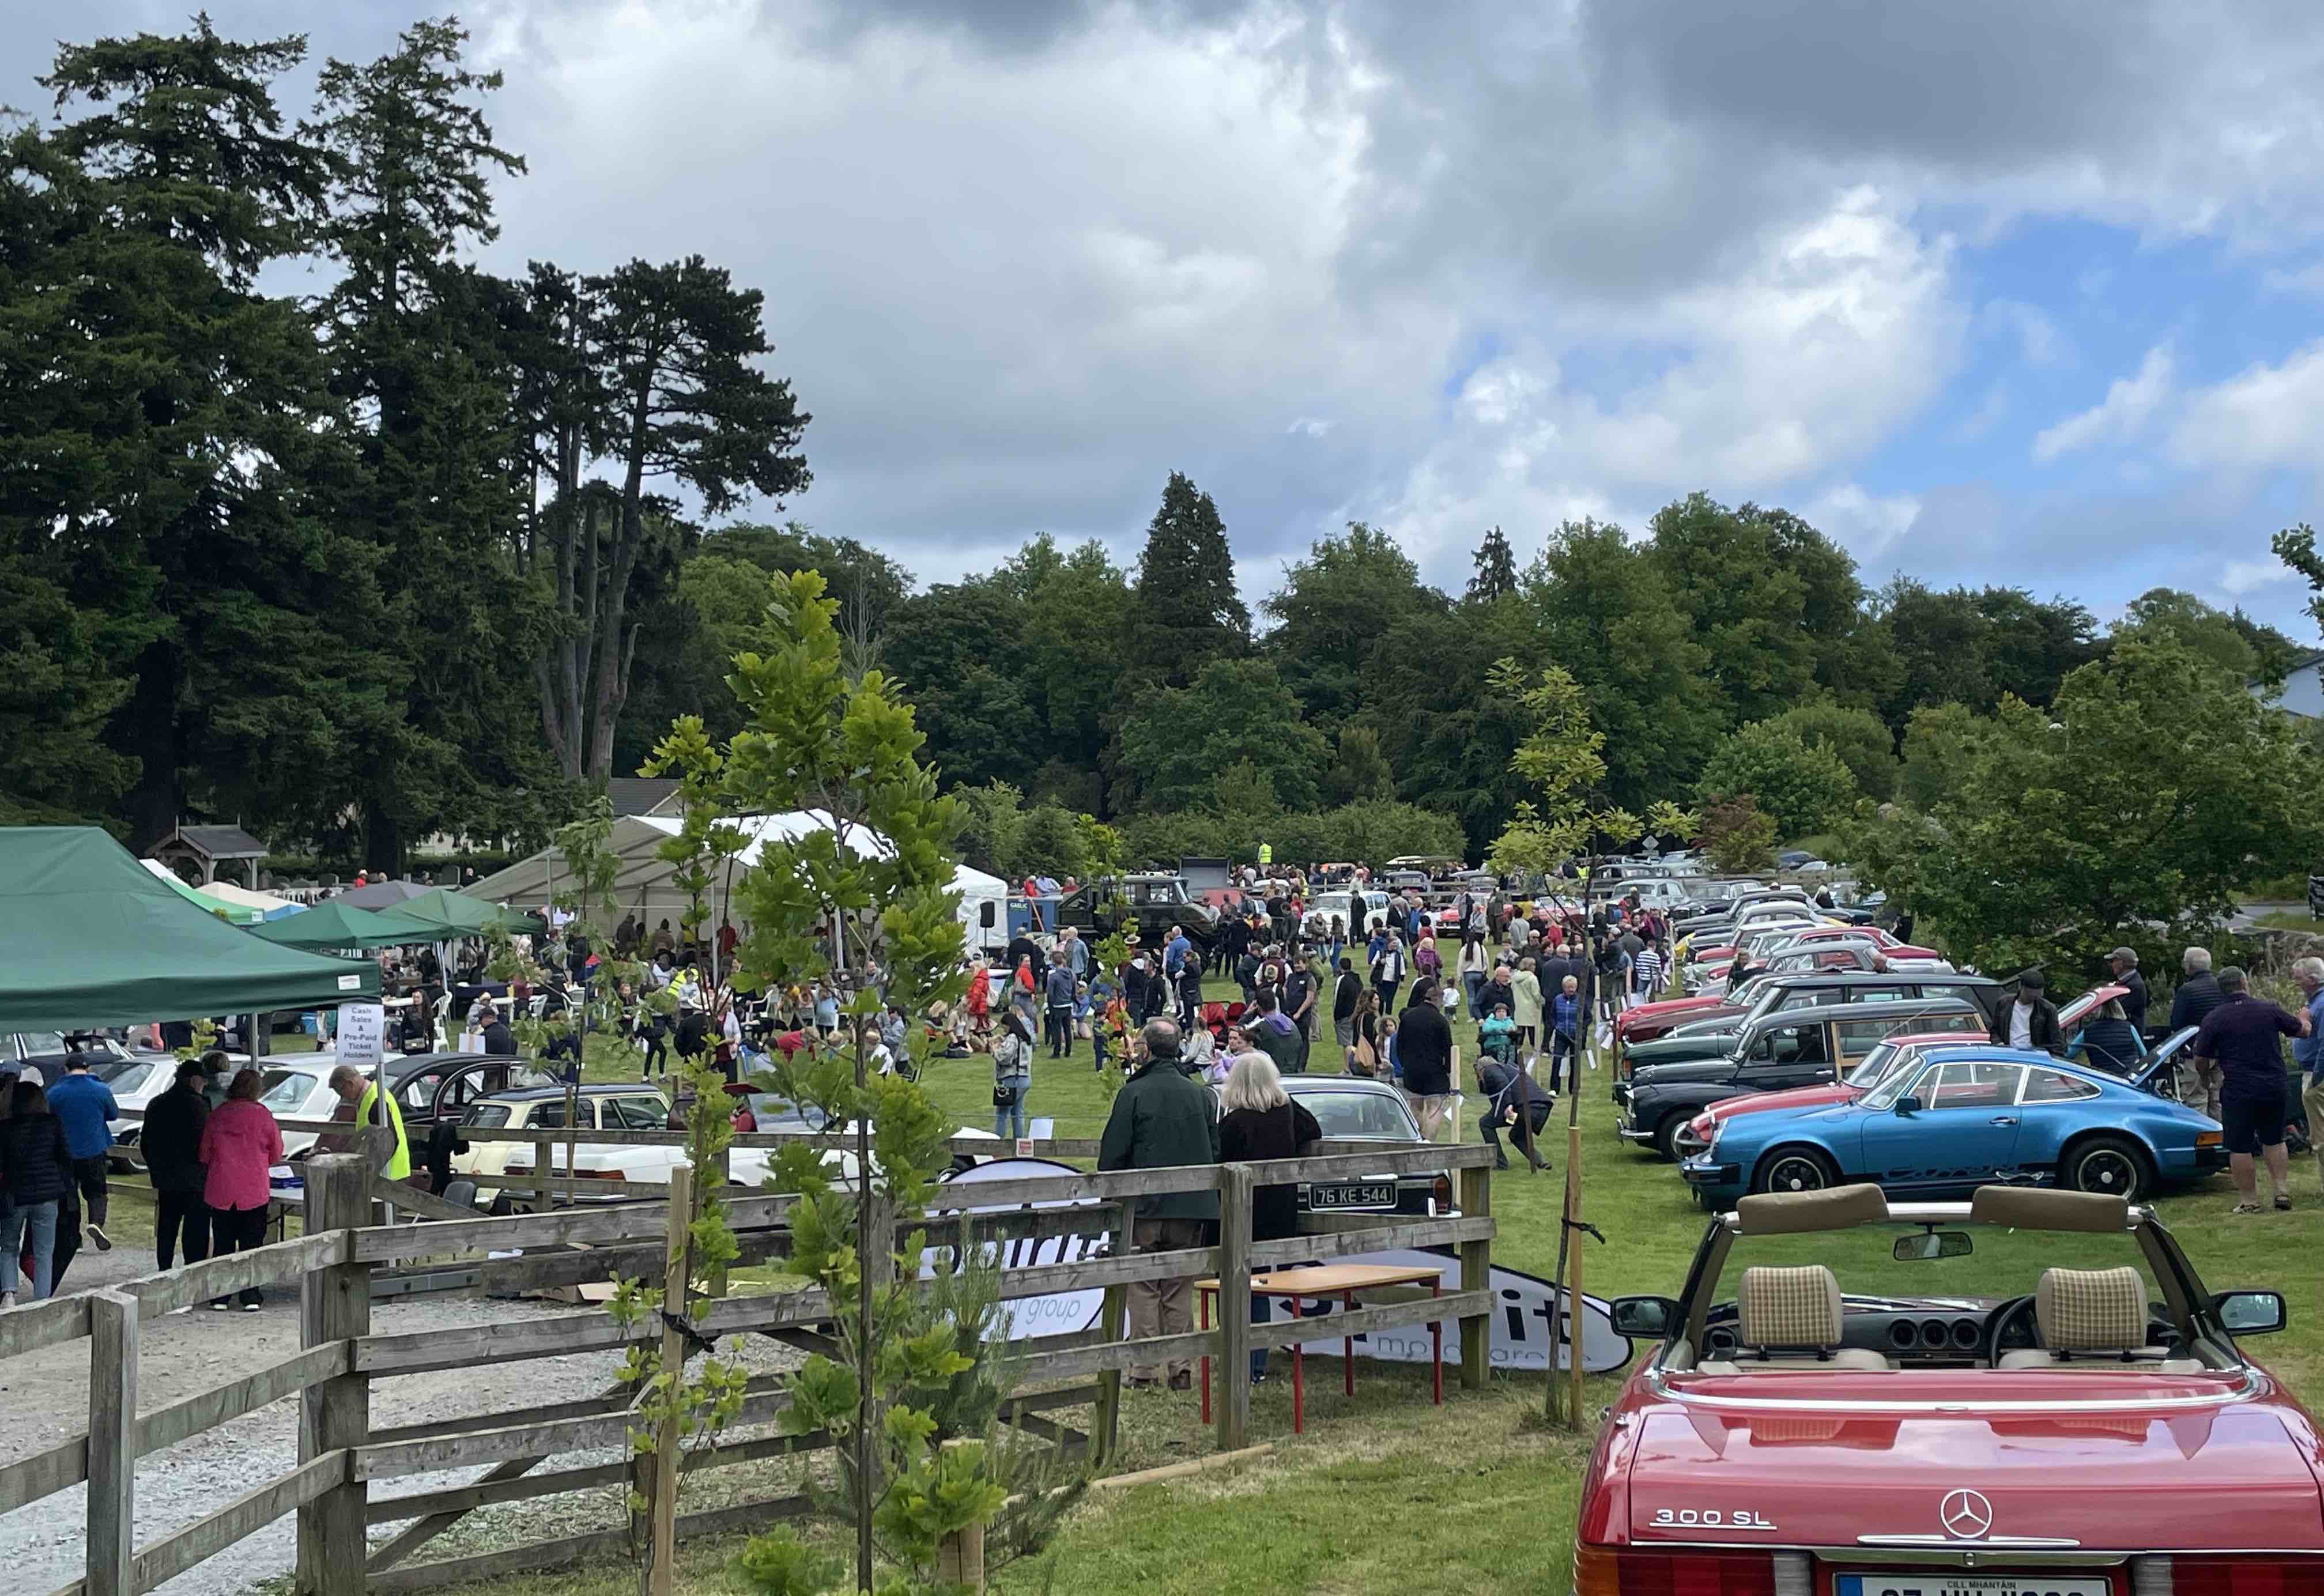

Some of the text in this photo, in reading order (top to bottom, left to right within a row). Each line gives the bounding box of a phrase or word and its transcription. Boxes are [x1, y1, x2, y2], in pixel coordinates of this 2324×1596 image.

[1318, 1188, 1387, 1203] 76 KE 544
[1025, 1299, 1081, 1325] group
[1656, 1509, 1771, 1525] 300 SL
[1947, 1580, 1967, 1589] CILL
